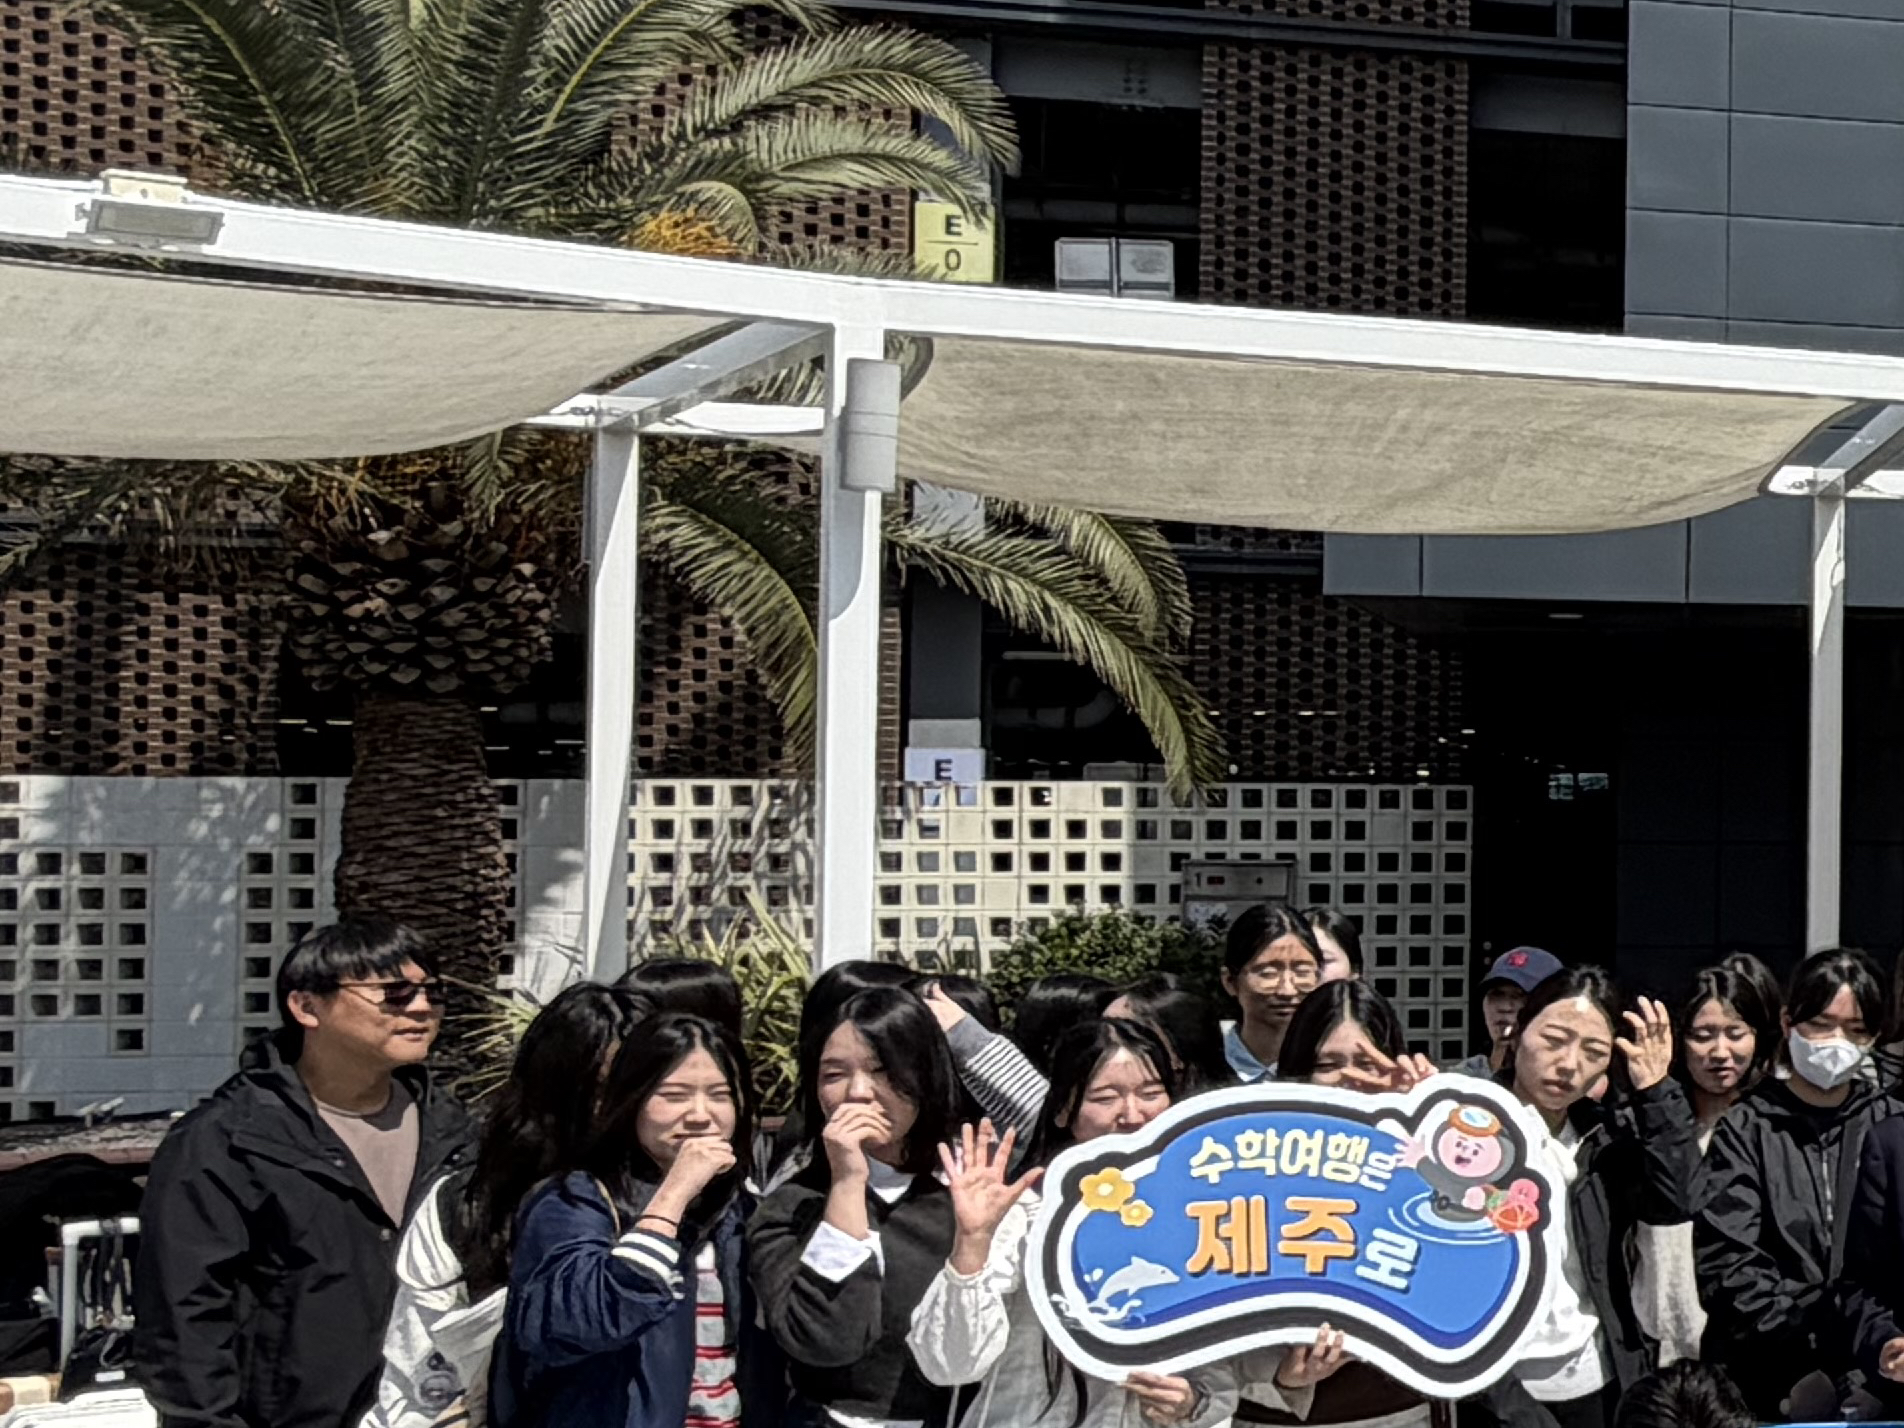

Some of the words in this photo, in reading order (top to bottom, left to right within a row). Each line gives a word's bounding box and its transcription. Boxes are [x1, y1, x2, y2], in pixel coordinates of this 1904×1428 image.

[945, 214, 963, 237] E
[935, 759, 952, 781] E
[1188, 1128, 1396, 1192] 수학여행은
